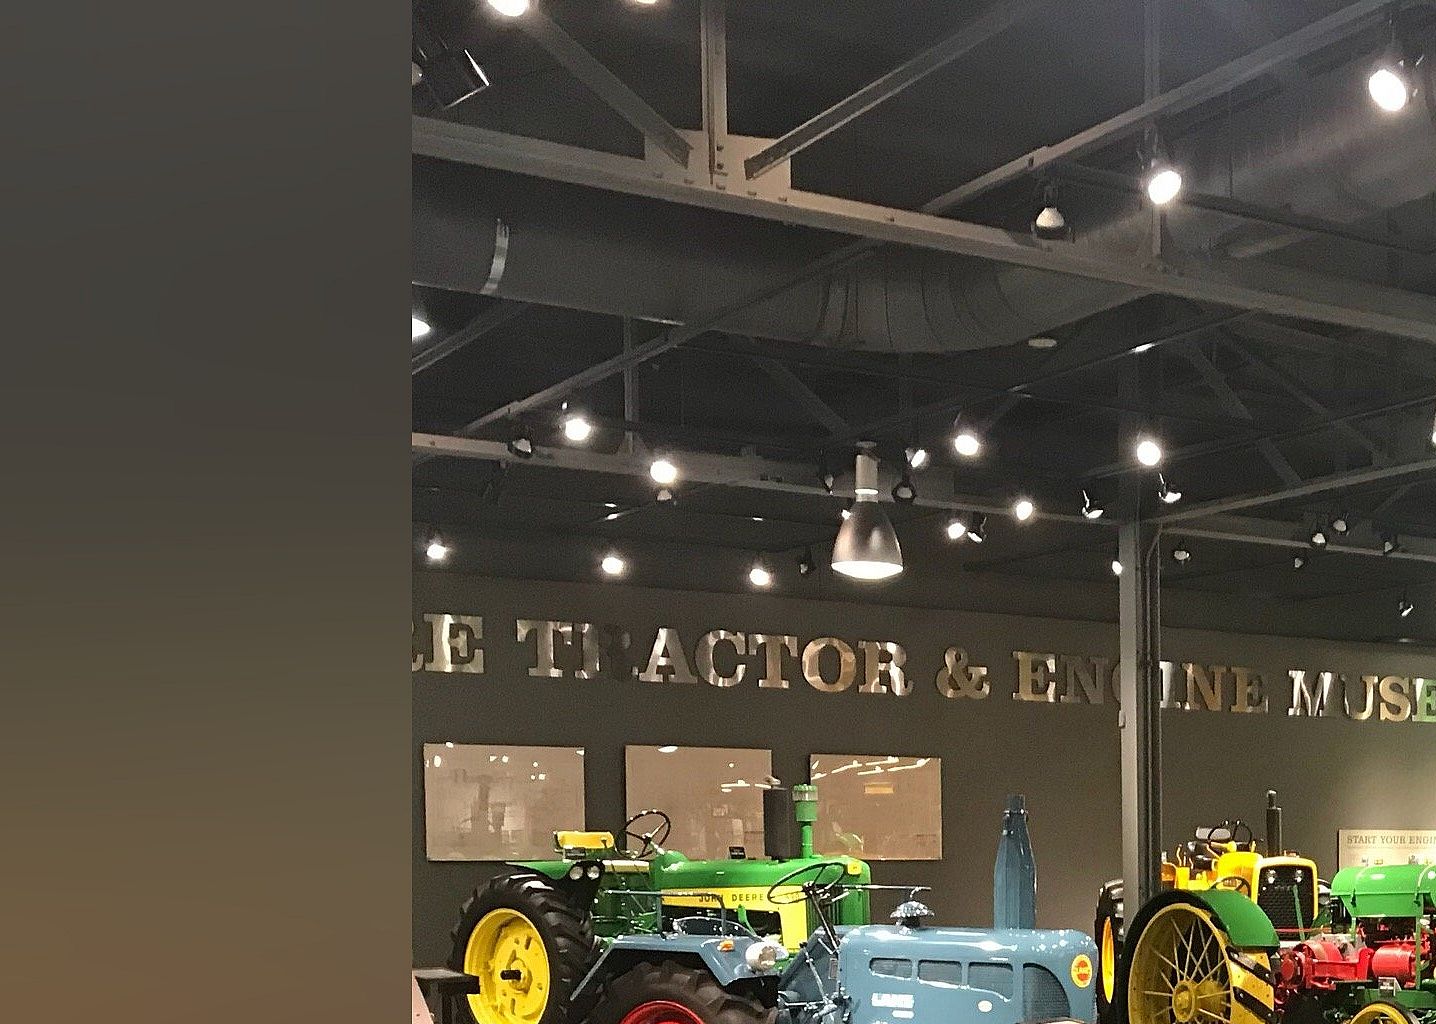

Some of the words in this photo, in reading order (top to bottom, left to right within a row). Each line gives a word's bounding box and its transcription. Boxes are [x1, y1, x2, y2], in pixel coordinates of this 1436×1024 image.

[412, 613, 485, 674] E
[936, 646, 991, 700] &
[1012, 651, 1269, 713] ENINE
[1346, 835, 1377, 845] START
[1381, 835, 1406, 845] YOUR
[731, 893, 764, 902] DEERE
